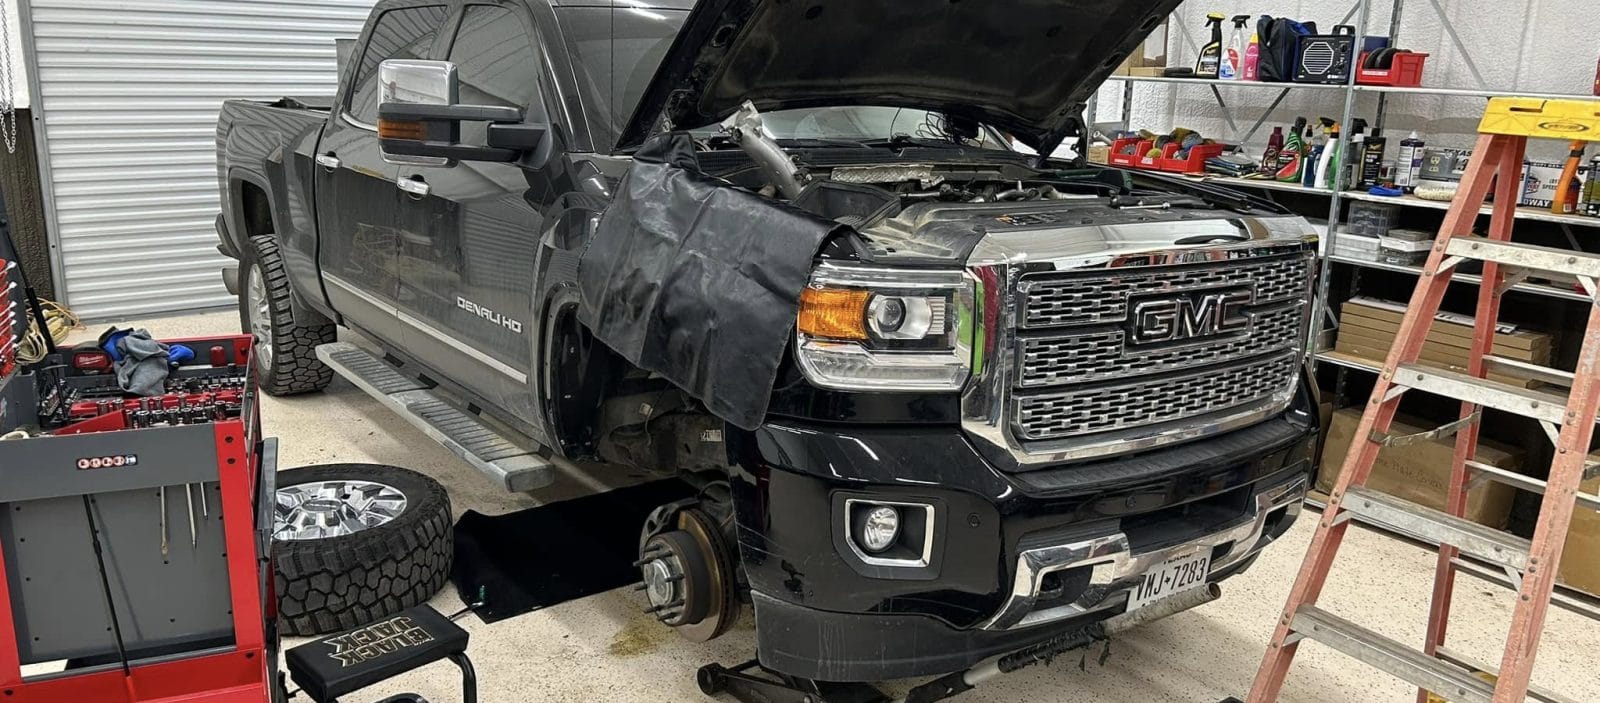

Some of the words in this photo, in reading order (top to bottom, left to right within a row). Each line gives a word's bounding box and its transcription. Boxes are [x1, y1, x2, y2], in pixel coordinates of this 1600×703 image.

[457, 296, 500, 325] DENALI
[503, 316, 522, 333] HD
[1132, 290, 1253, 344] GMC
[323, 616, 412, 653] JACK
[329, 626, 435, 667] BLACK
